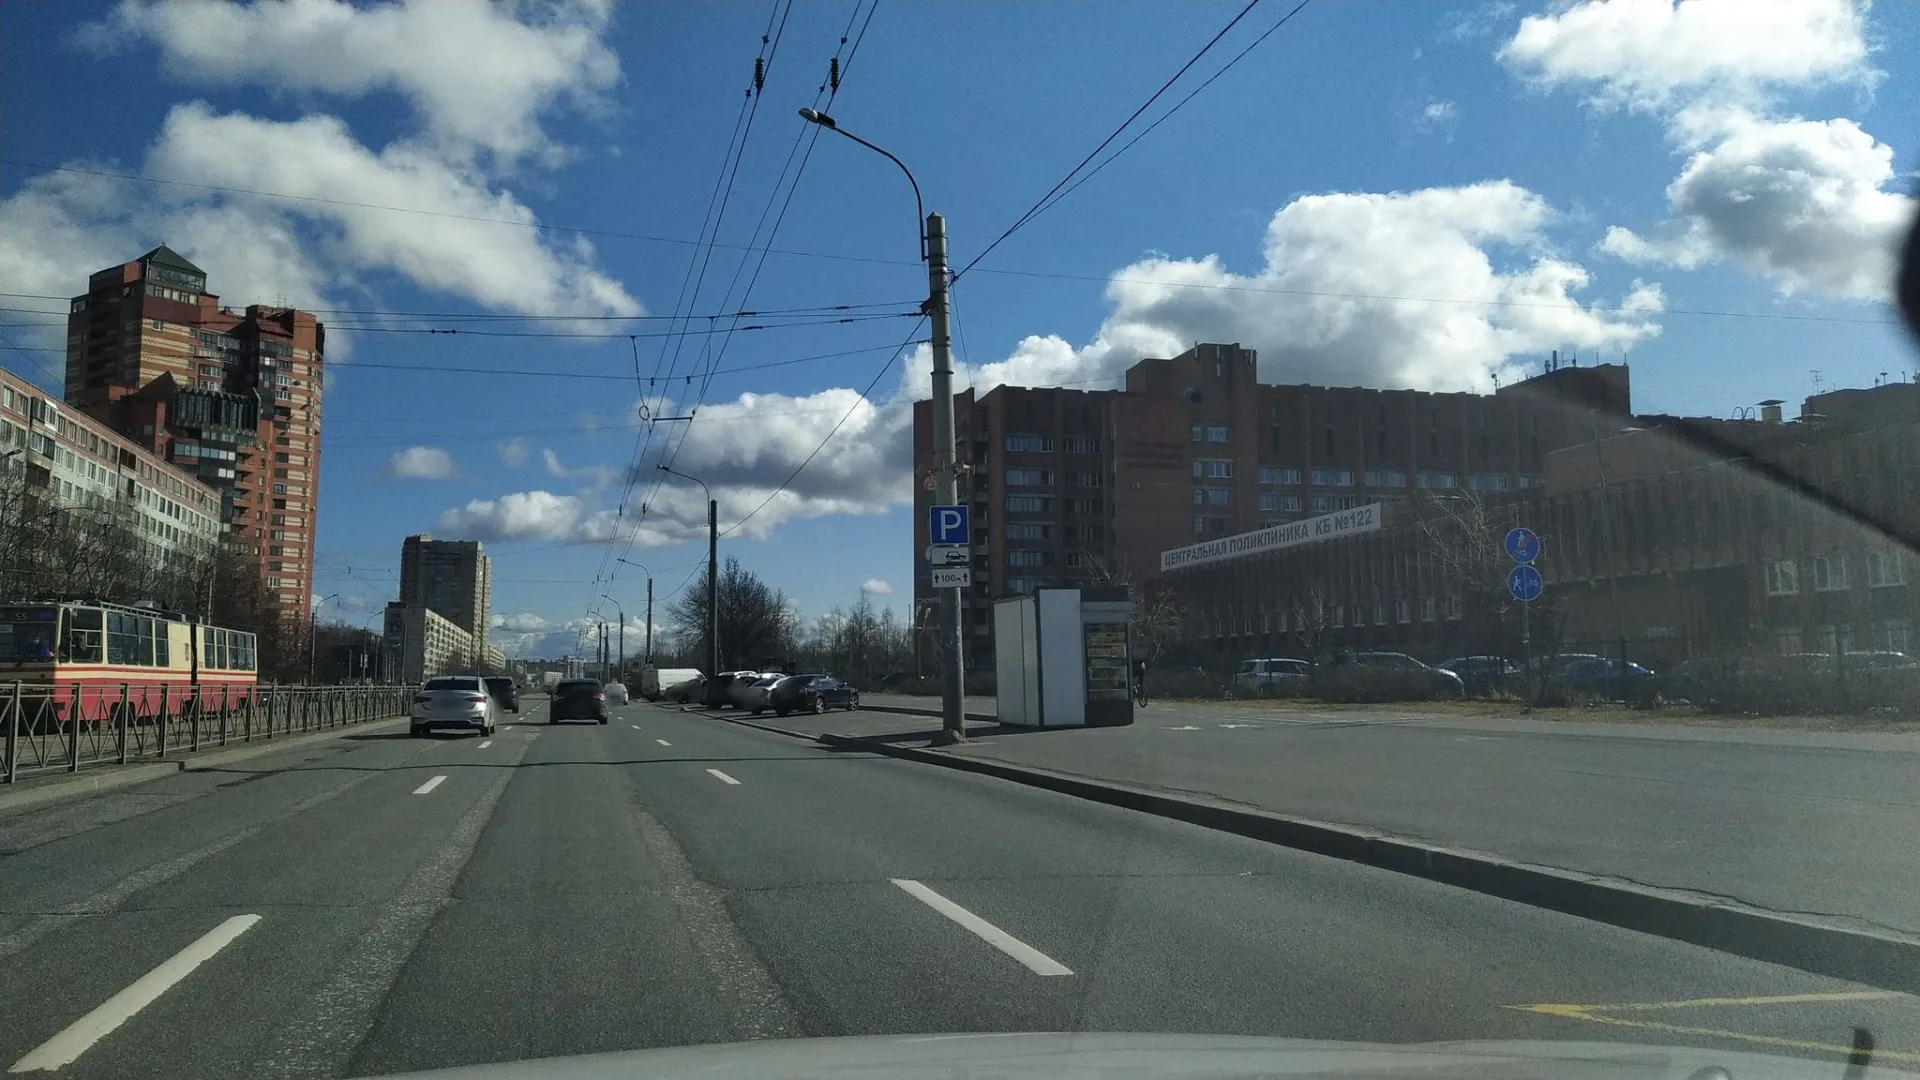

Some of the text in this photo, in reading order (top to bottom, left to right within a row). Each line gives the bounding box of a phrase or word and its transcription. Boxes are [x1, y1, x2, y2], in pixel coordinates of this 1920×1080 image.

[940, 510, 962, 540] P
[1165, 508, 1373, 567] ЦЕНТРАЛЬНАЯ ПОЛИКЛИНИКА КБ №122
